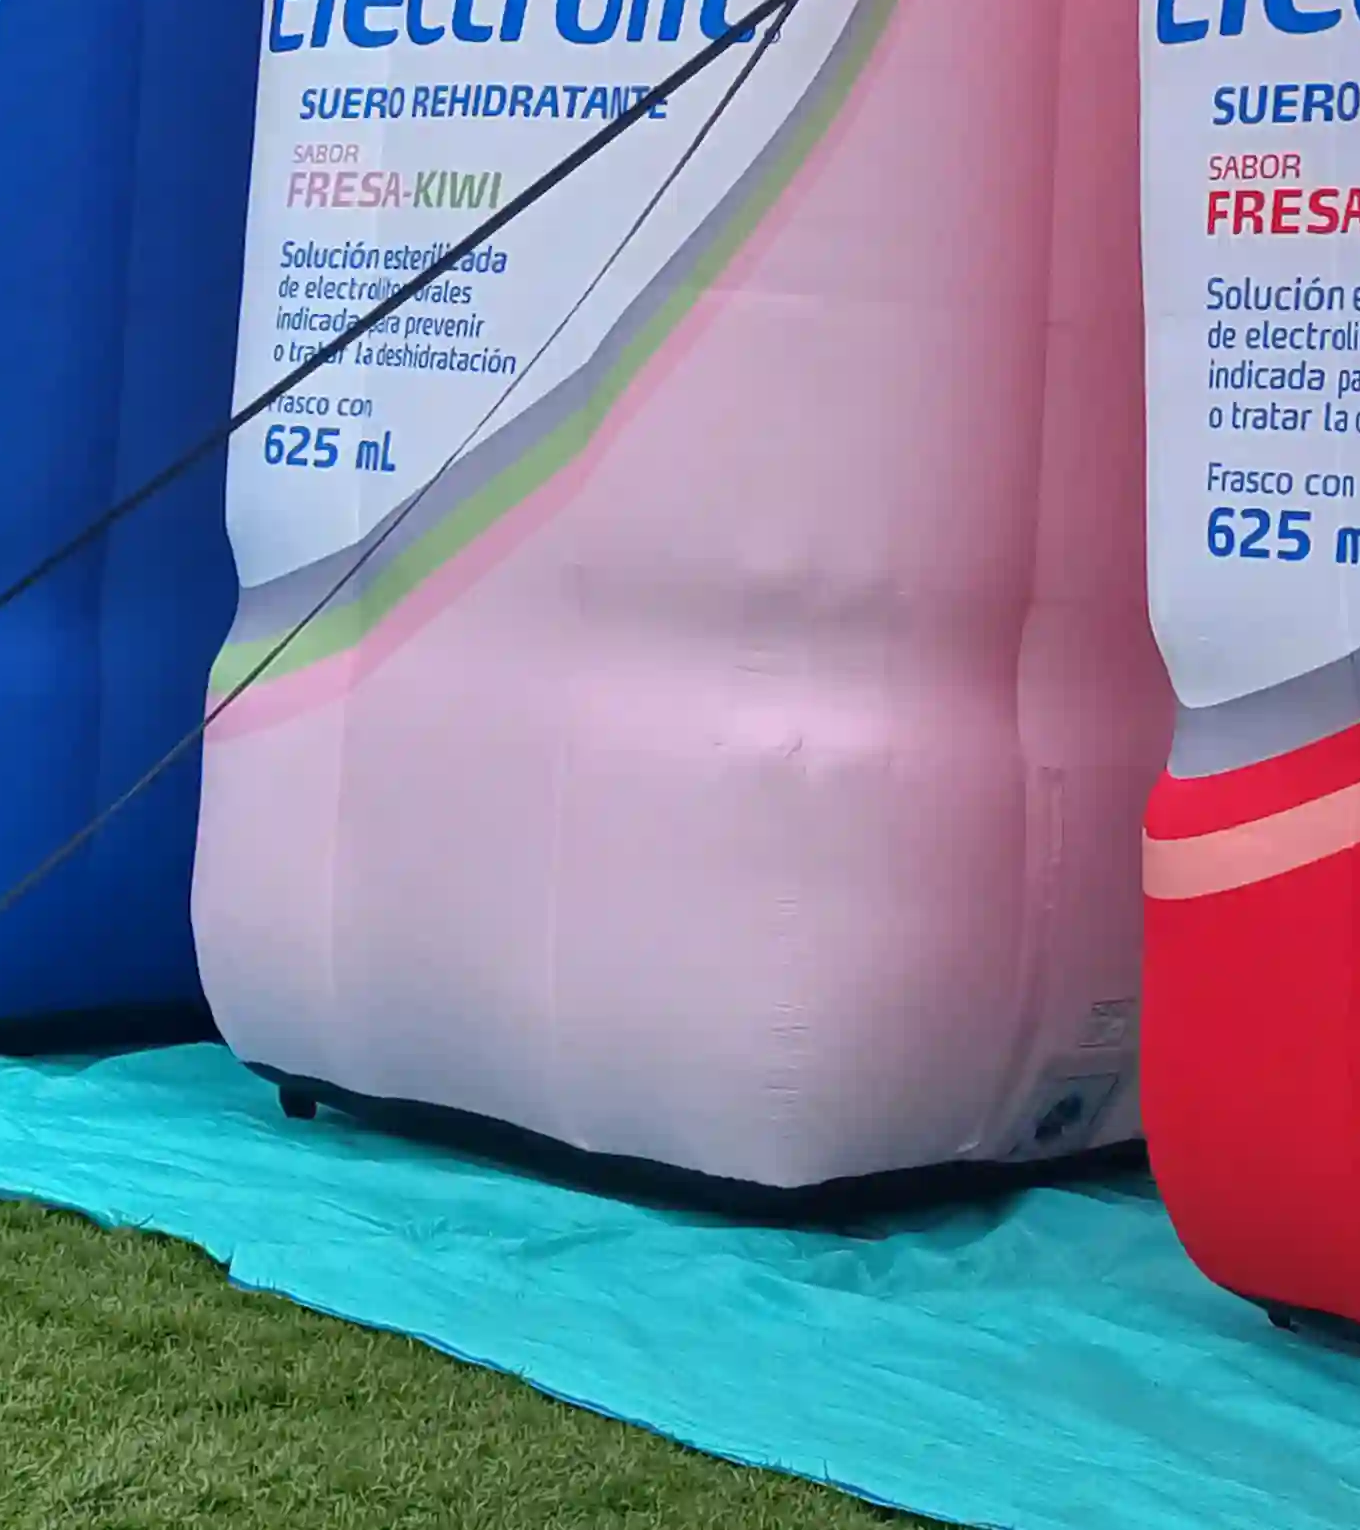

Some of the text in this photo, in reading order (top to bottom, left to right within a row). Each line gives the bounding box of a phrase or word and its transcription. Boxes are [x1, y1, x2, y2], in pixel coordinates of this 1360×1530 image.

[299, 87, 404, 120] SUERO
[1212, 81, 1360, 126] SUERO
[292, 144, 360, 165] SABOR
[1208, 153, 1301, 181] SABOR
[286, 170, 504, 209] FRESA-KIWI
[280, 240, 379, 270] Solución
[278, 275, 299, 299] de
[1207, 276, 1345, 312] Solución
[276, 306, 360, 332] indicada
[404, 313, 486, 340] prevenir
[1207, 322, 1236, 349] de
[273, 344, 284, 362] o
[355, 341, 373, 365] la
[376, 342, 517, 375] deshidratación
[1208, 360, 1325, 392] indicada
[337, 397, 373, 418] con
[1208, 406, 1223, 429] o
[1231, 404, 1312, 432] tratar
[1323, 403, 1349, 434] la
[264, 424, 396, 472] 625 mL
[1207, 463, 1355, 498] Frasco con
[1206, 507, 1312, 562] 625
